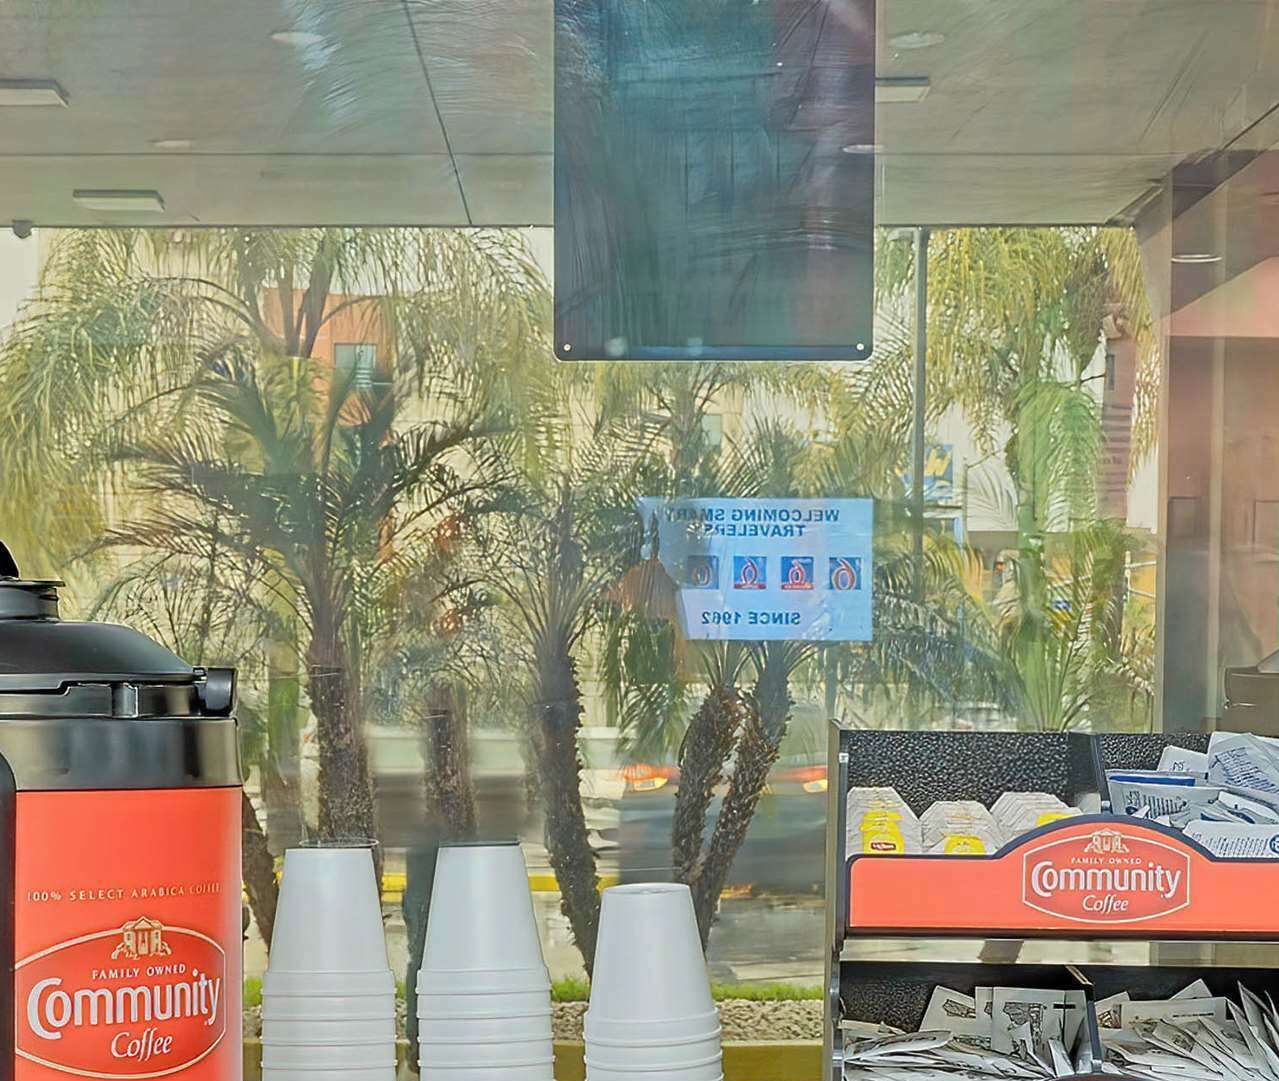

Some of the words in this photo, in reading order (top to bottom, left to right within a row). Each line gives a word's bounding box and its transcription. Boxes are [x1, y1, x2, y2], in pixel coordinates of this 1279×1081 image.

[26, 890, 62, 902] 100%
[69, 888, 124, 901] SELECT
[131, 885, 185, 898] ARABICA
[1030, 861, 1182, 899] Community
[1082, 893, 1130, 915] Coffee
[91, 967, 140, 980] FAMILY
[146, 962, 186, 976] OWNED
[26, 968, 221, 1041] Community
[110, 1026, 173, 1063] Coffee
